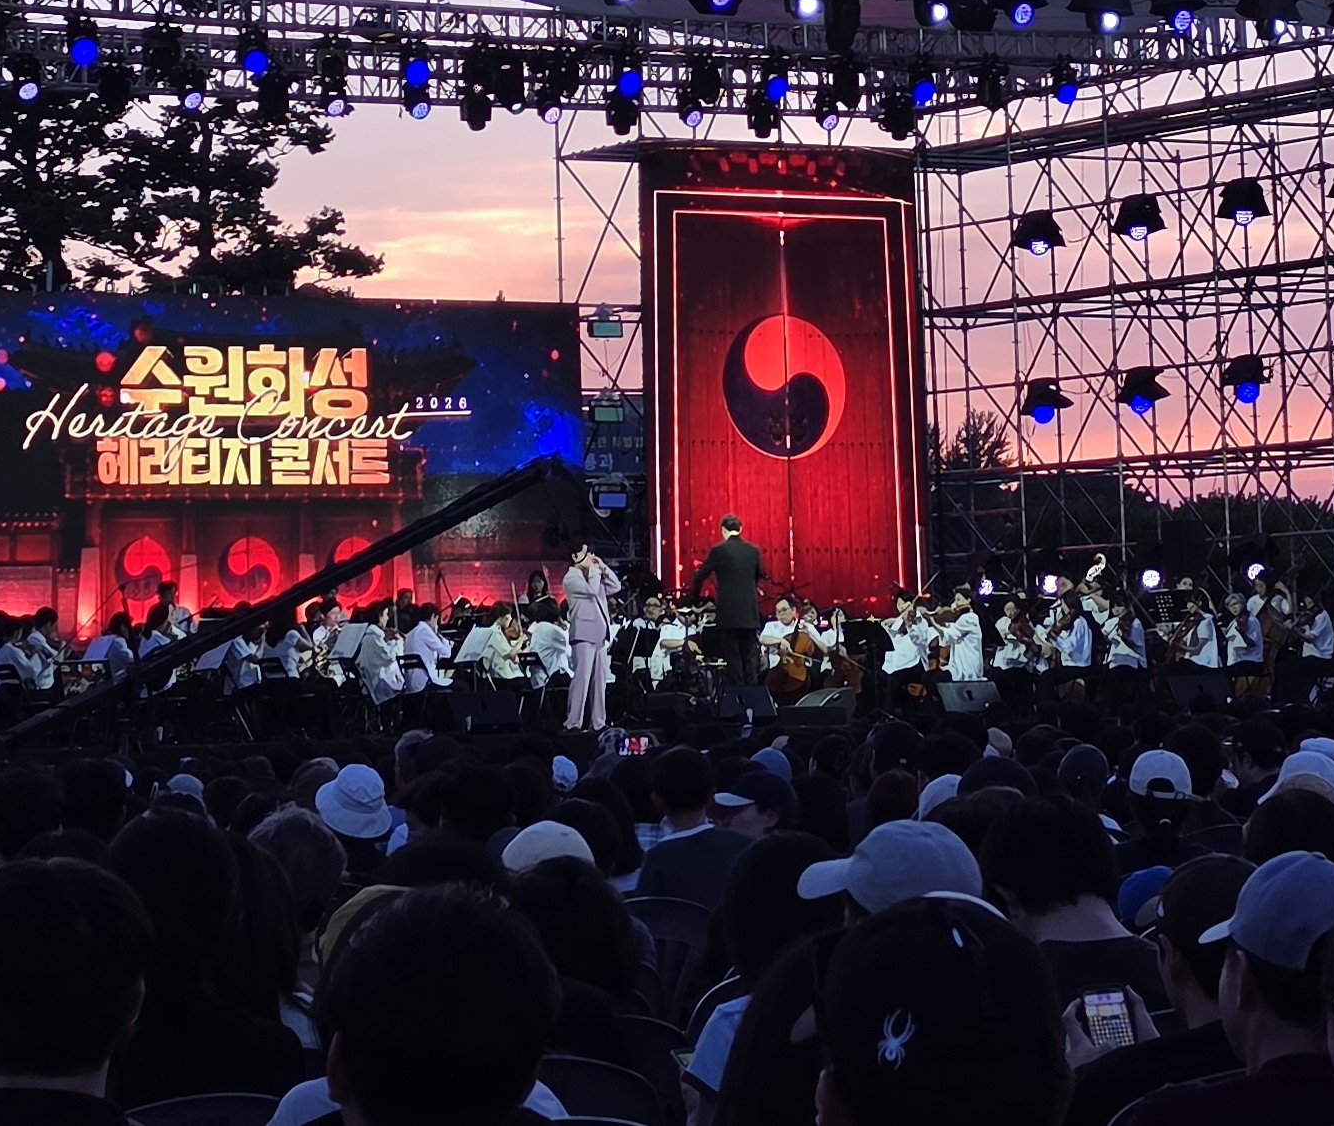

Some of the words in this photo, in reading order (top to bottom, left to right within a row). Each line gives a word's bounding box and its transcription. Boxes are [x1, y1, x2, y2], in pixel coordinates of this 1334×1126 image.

[120, 344, 369, 420] 수원화성
[22, 382, 224, 473] Heritage
[237, 388, 414, 445] Concert
[415, 396, 468, 410] 2026
[97, 437, 262, 485] 헤리티지
[268, 437, 390, 485] 콘서트
